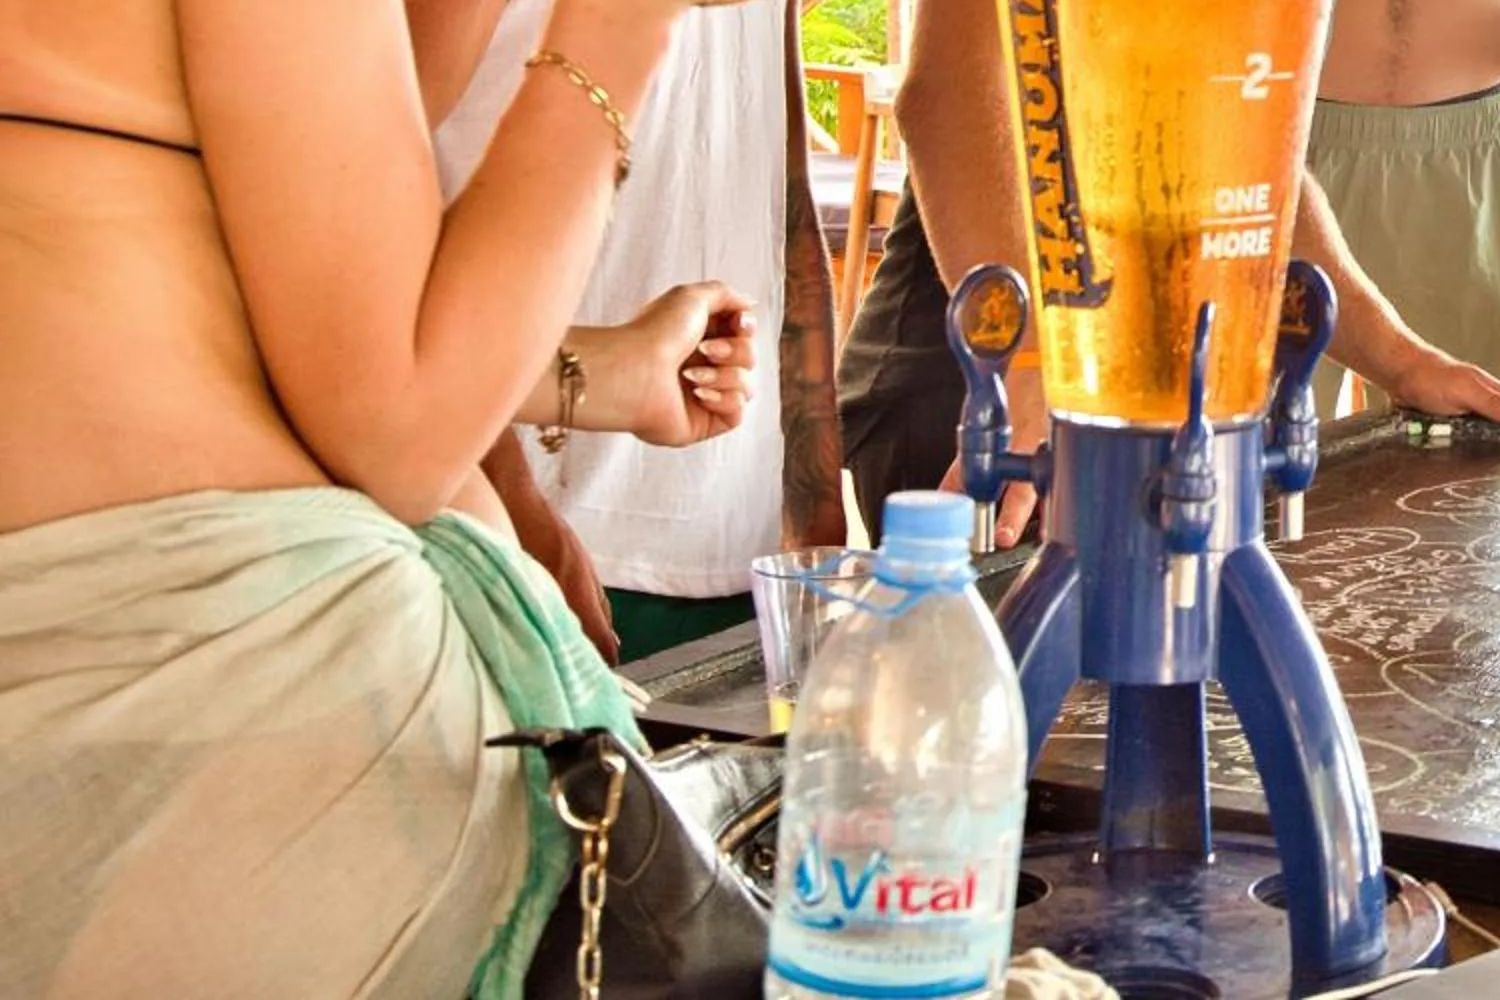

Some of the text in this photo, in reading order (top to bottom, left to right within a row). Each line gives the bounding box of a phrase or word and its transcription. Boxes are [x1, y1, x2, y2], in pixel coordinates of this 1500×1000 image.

[1241, 53, 1272, 99] 2
[1215, 184, 1271, 214] ONE
[1201, 228, 1273, 259] MORE
[831, 850, 976, 915] Vital
